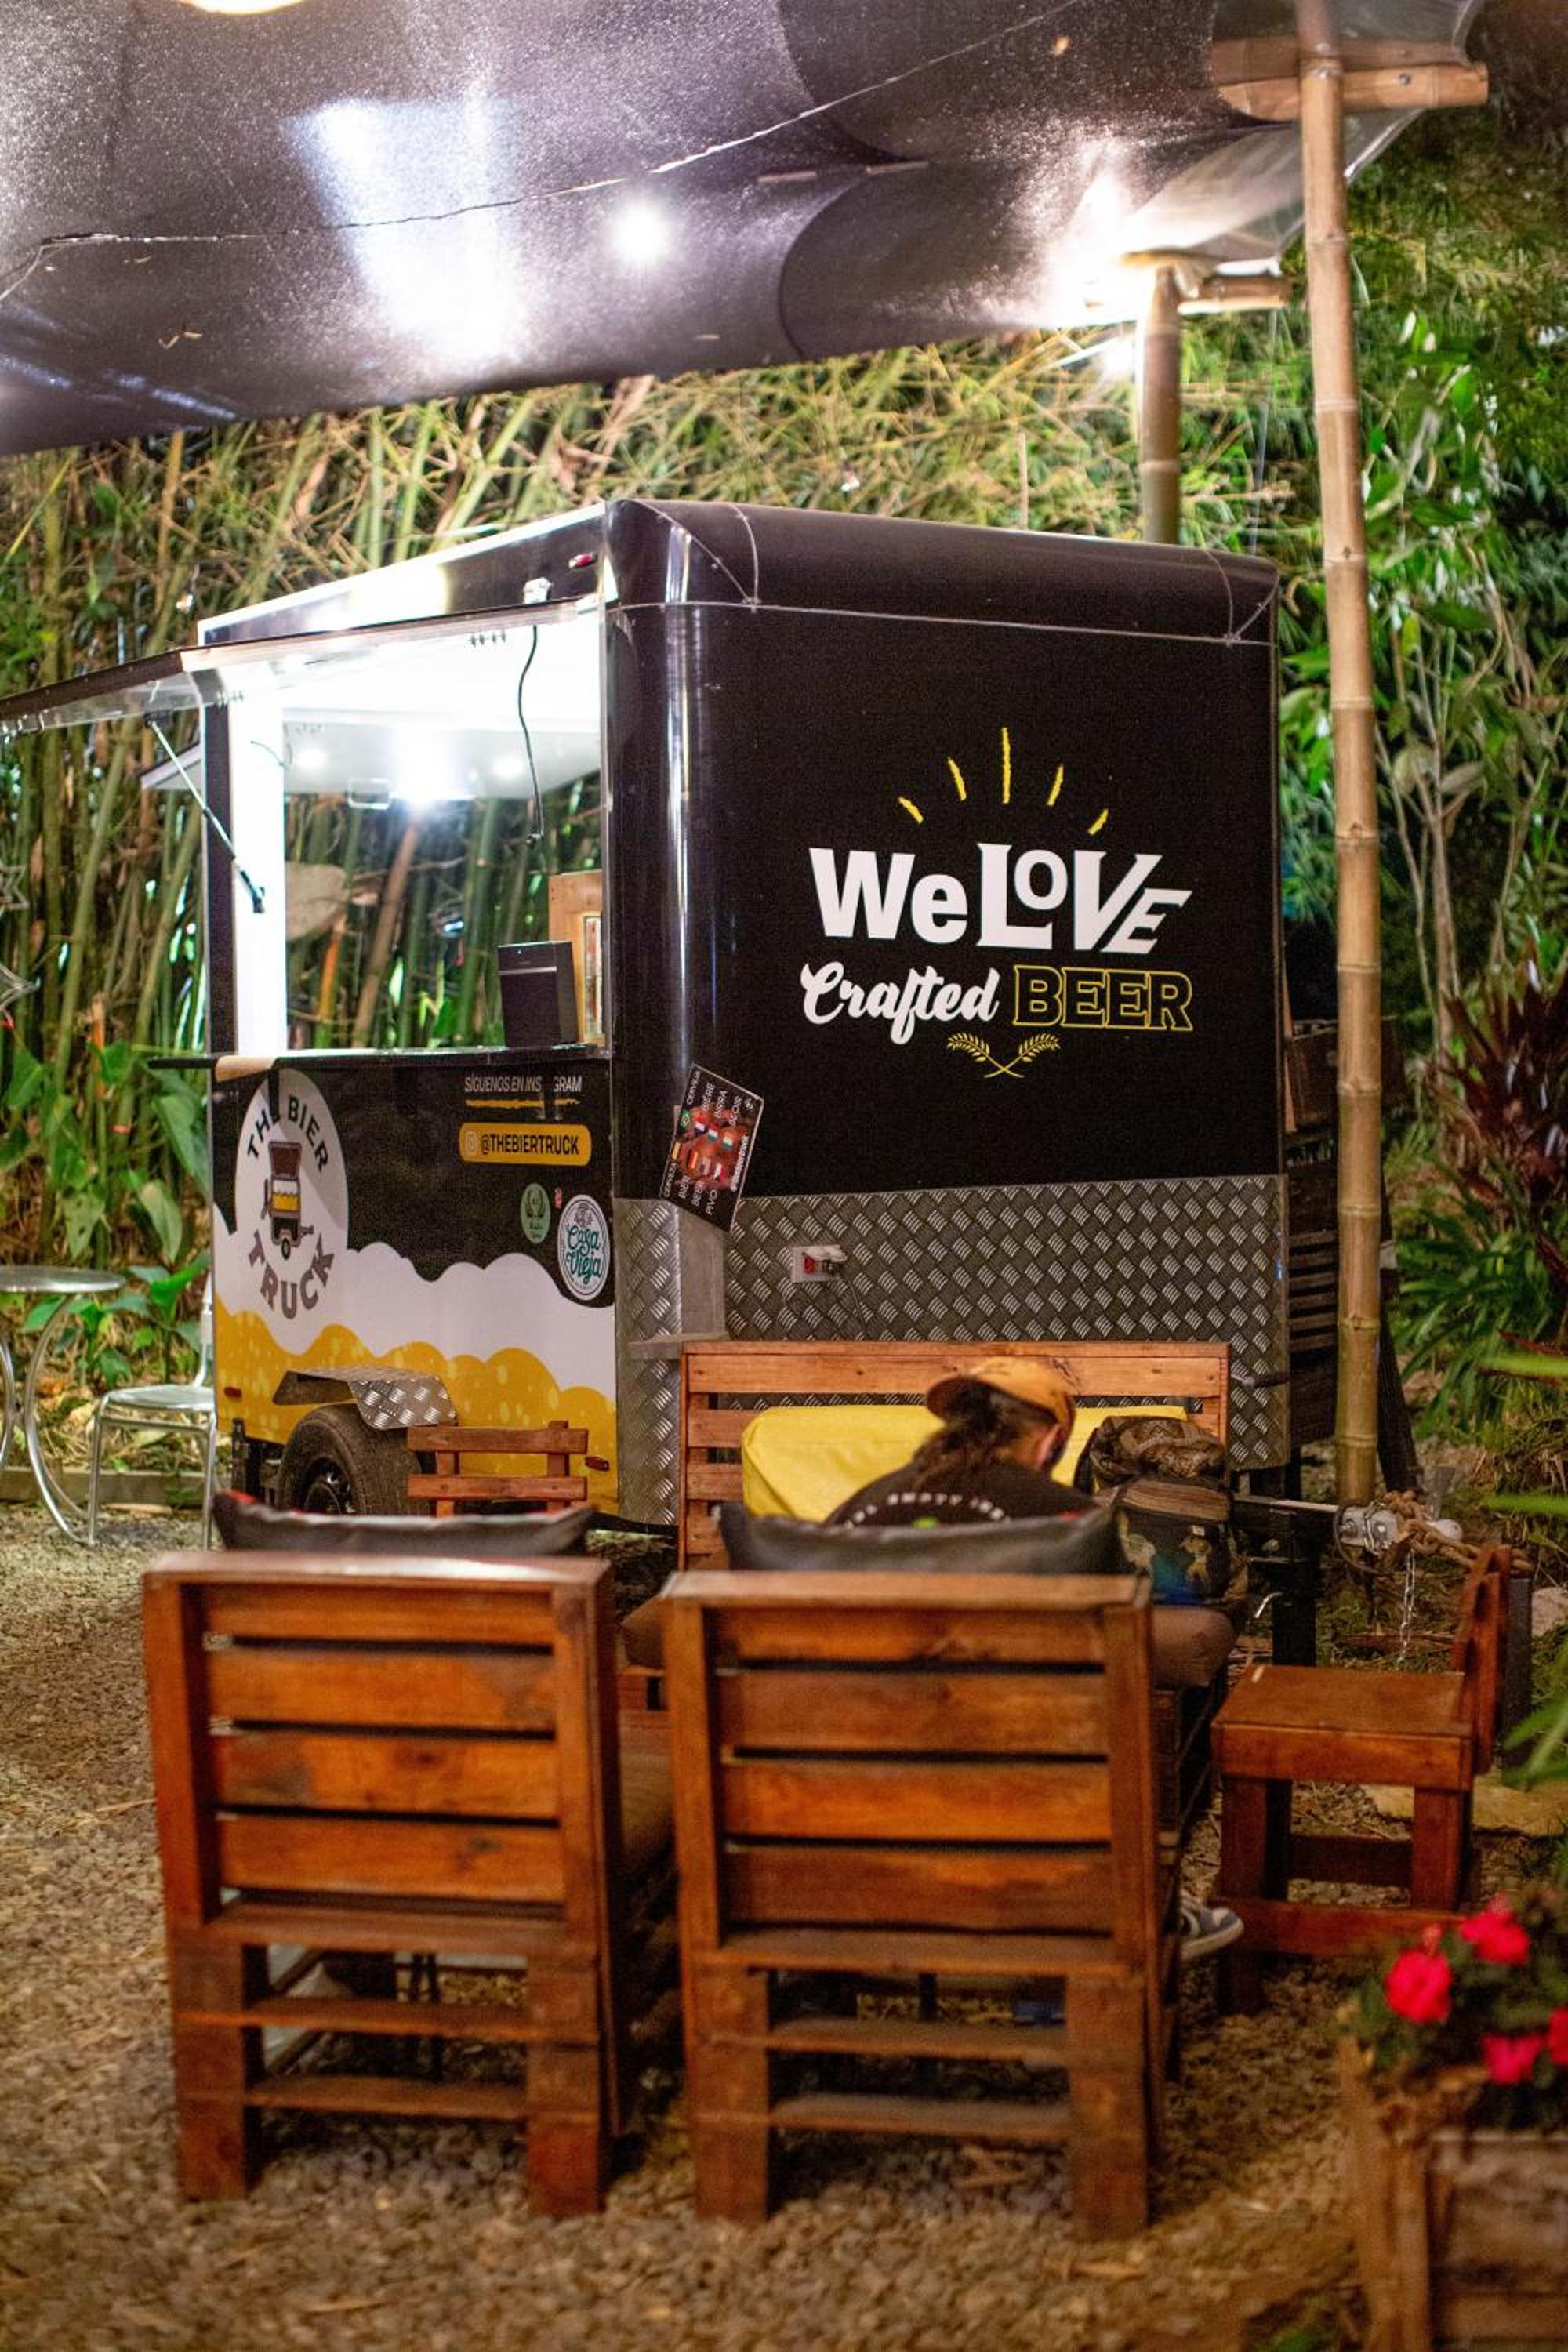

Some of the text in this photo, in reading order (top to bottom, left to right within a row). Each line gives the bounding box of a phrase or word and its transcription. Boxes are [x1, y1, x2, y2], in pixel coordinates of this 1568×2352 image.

[808, 847, 968, 945] We
[800, 960, 1193, 1045] Crafted BEER
[511, 1076, 524, 1092] EN
[525, 1075, 583, 1092] INSGRAM
[247, 1094, 329, 1172] TH BIER
[481, 1134, 579, 1156] @THEBIERTRUCK
[247, 1229, 335, 1320] TRUCK
[565, 1249, 602, 1285] Vieja
